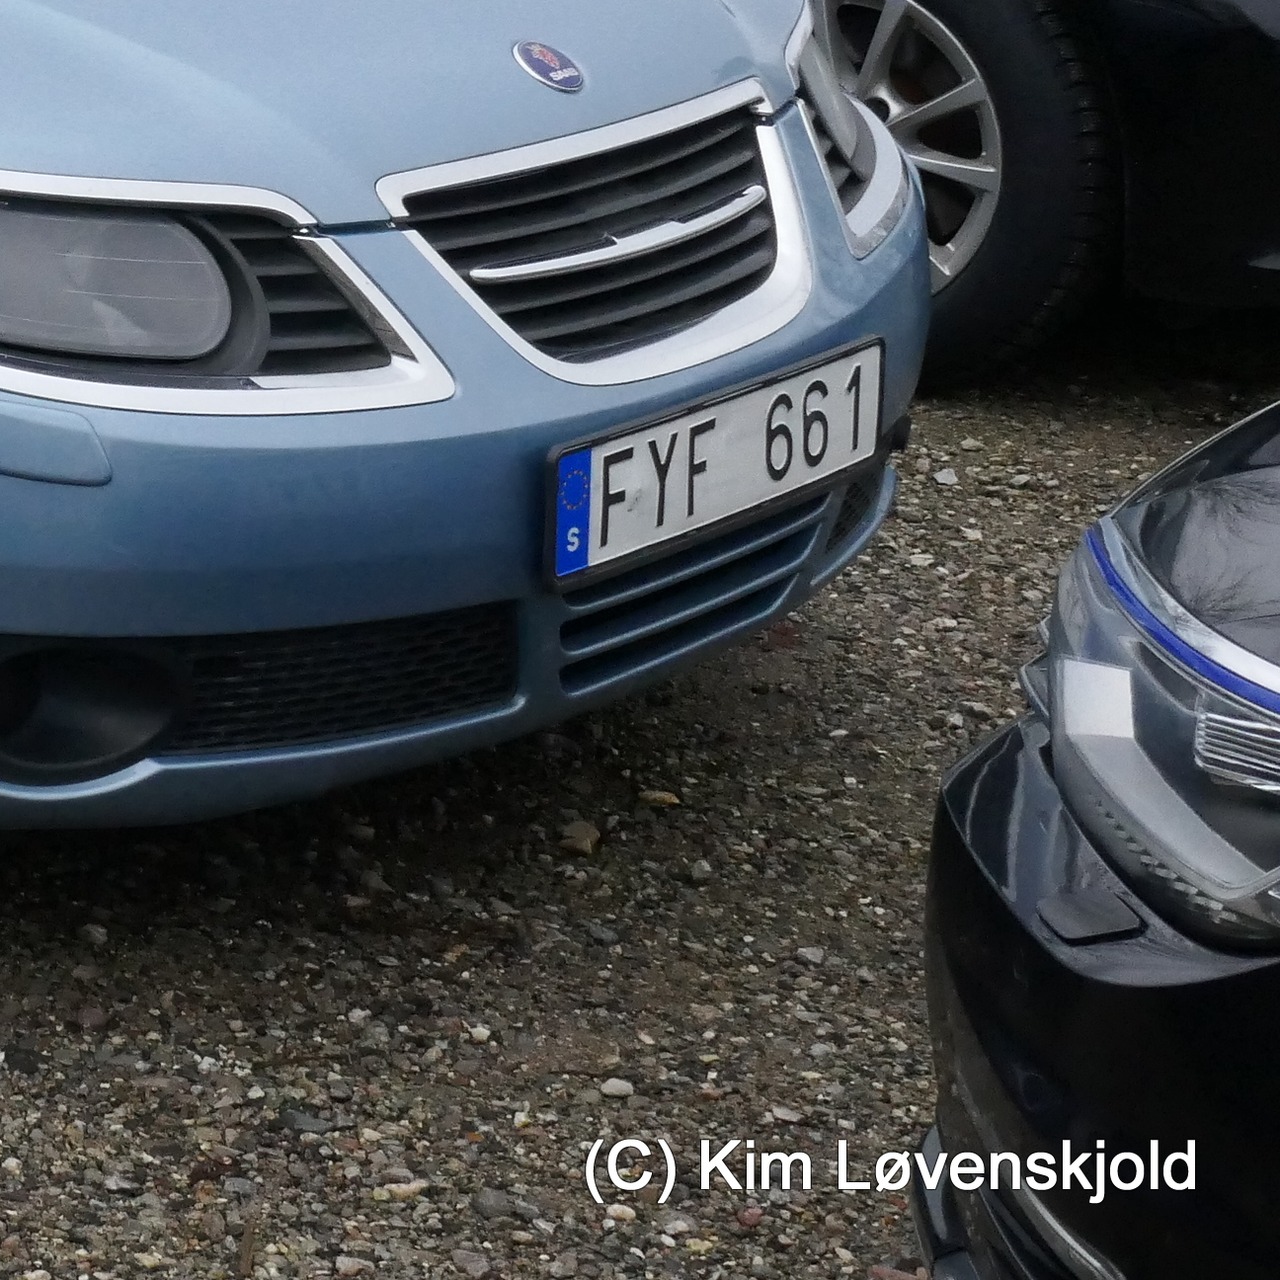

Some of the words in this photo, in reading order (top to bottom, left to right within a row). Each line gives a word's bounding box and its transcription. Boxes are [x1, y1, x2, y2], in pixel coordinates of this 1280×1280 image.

[549, 67, 579, 81] SAAB
[598, 417, 717, 550] FYF
[764, 363, 862, 483] 661
[566, 526, 580, 553] S
